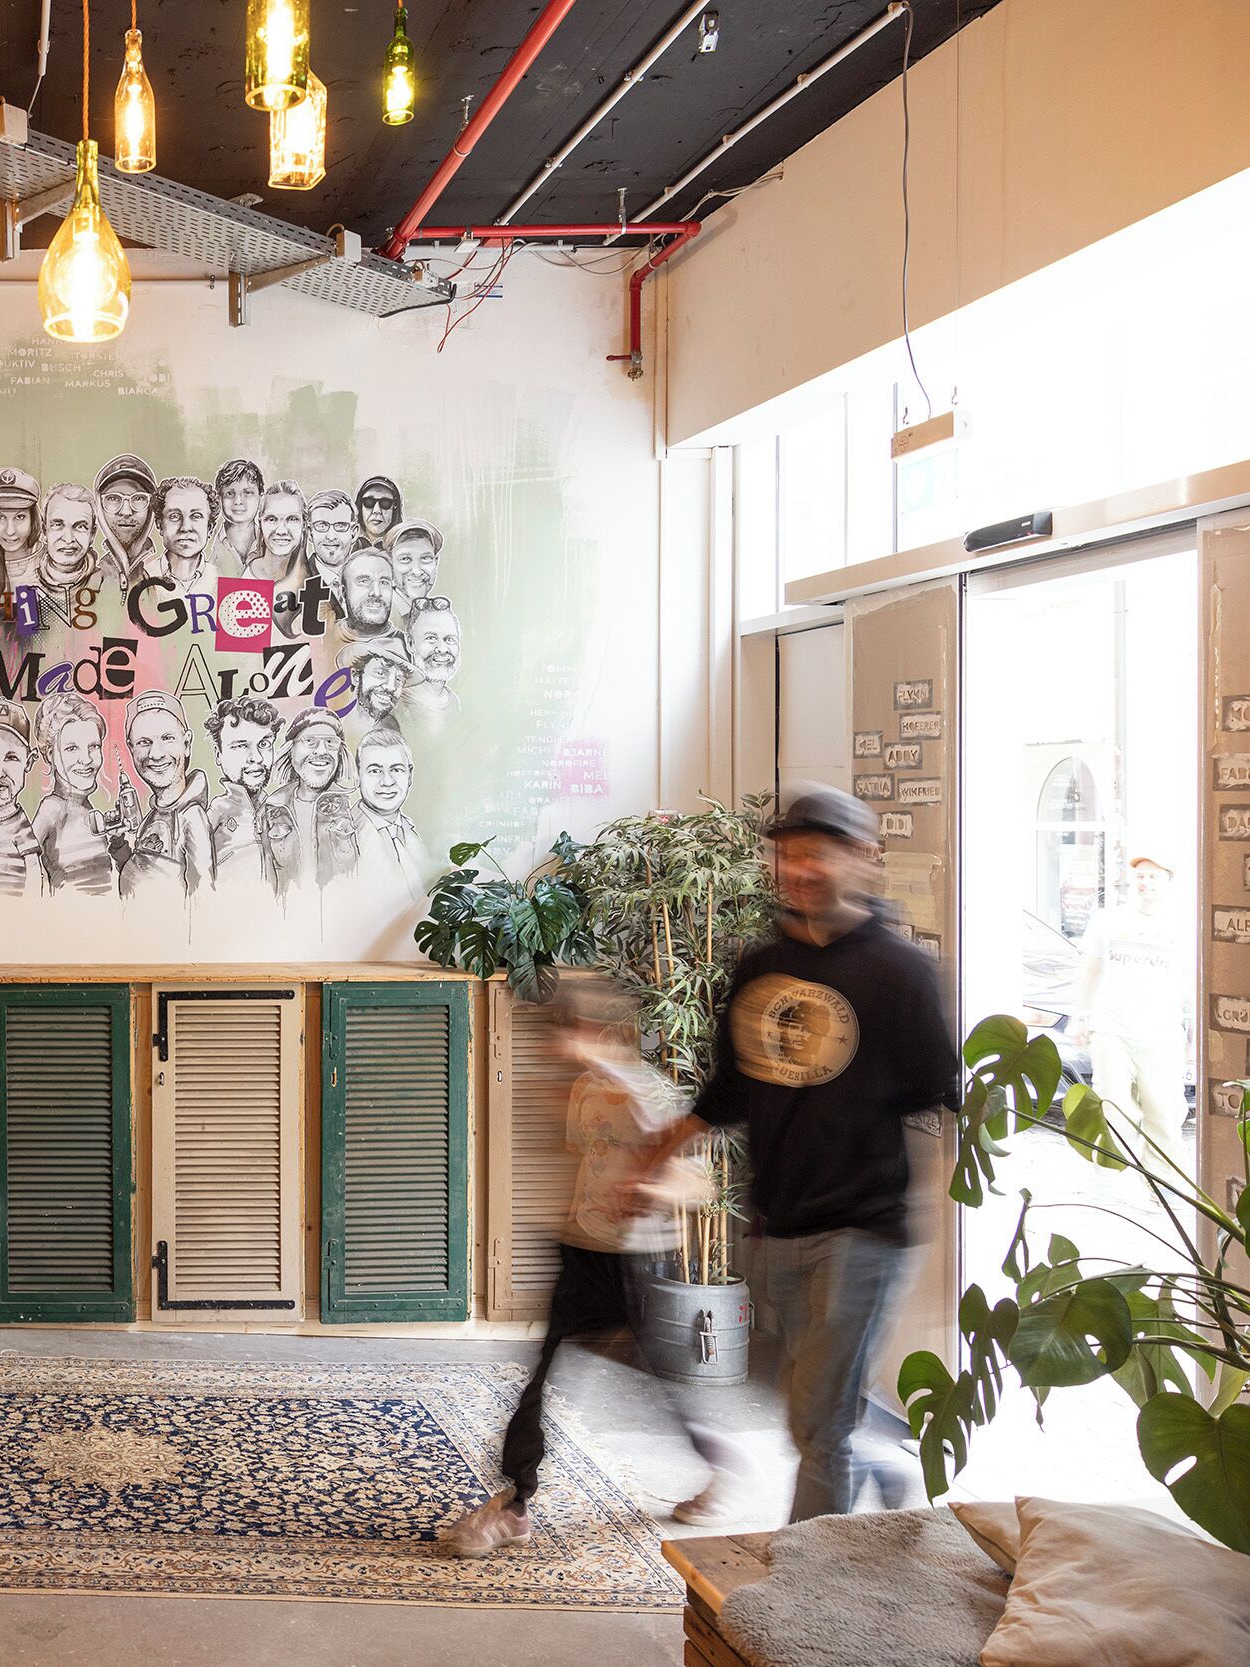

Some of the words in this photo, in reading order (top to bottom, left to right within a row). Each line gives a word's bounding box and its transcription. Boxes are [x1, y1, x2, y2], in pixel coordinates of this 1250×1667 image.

[8, 348, 53, 358] MORITZ
[93, 369, 125, 378] CHRIS
[10, 376, 51, 386] FABIAN
[65, 379, 112, 389] MARKUS
[118, 386, 159, 396] BIANCA
[524, 779, 562, 790] KARIN
[768, 988, 850, 1025] SCHWARZWALD
